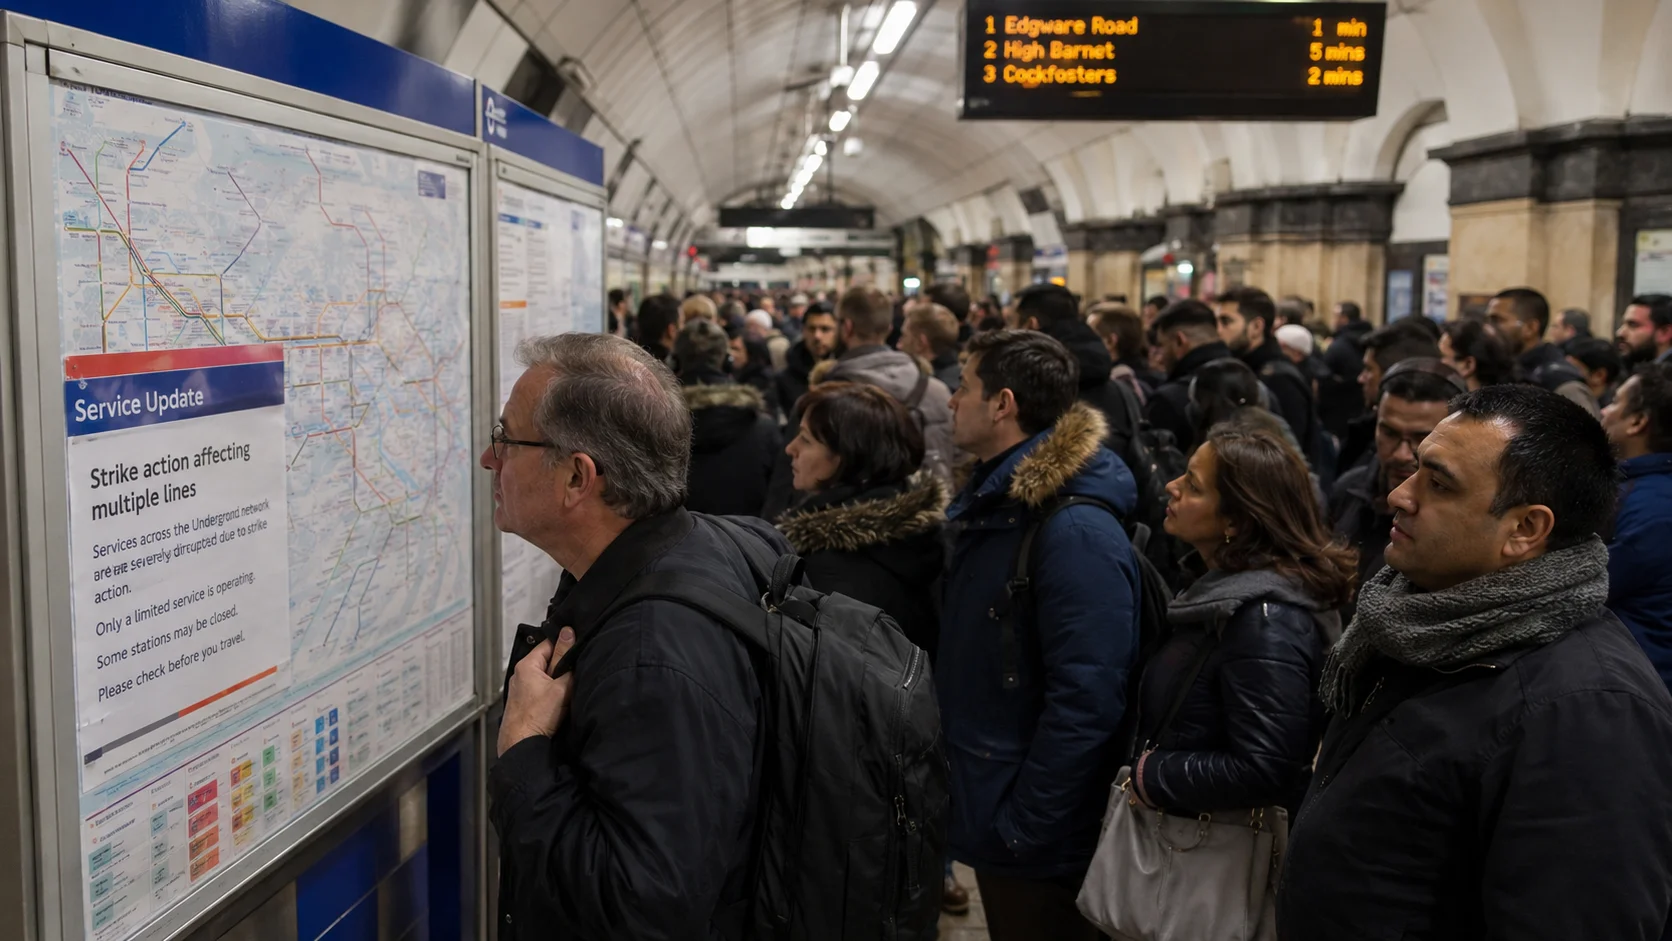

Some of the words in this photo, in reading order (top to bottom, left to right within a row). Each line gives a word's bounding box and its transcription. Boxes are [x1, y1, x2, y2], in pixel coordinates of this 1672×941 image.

[985, 15, 996, 35] 1
[1005, 15, 1086, 38] Edgware
[1091, 15, 1138, 35] Road
[1312, 18, 1323, 37] 1
[1337, 17, 1367, 37] min
[983, 40, 997, 59] 2
[1003, 40, 1045, 62] High
[1050, 40, 1115, 59] Barnet
[1309, 42, 1323, 61] 5
[1325, 42, 1365, 61] mins
[983, 64, 997, 84] 3
[1003, 64, 1117, 84] Cockfosters
[1307, 66, 1321, 85] 2
[1323, 66, 1364, 85] mins
[75, 395, 141, 422] Service
[146, 388, 204, 415] Update
[90, 463, 138, 489] Strike
[143, 454, 189, 478] action
[194, 442, 250, 467] affecting
[92, 488, 159, 520] multiple
[164, 482, 196, 504] lines
[93, 537, 138, 559] Services
[140, 528, 171, 546] across
[173, 522, 189, 536] the
[94, 566, 112, 582] are
[219, 530, 235, 543] due
[237, 526, 246, 538] to
[247, 519, 267, 534] strike
[94, 584, 132, 604] action.
[96, 614, 122, 636] Only
[125, 614, 132, 626] a
[134, 599, 170, 623] limited
[172, 589, 205, 609] service
[207, 585, 214, 597] is
[216, 570, 256, 596] operating.
[97, 647, 127, 669] Some
[131, 632, 171, 656] stations
[174, 623, 193, 640] may
[196, 618, 208, 631] be
[209, 604, 239, 626] closed.
[98, 679, 133, 702] Please
[136, 664, 166, 686] check
[168, 652, 199, 673] before
[201, 643, 218, 661] you
[220, 630, 246, 651] travel.
